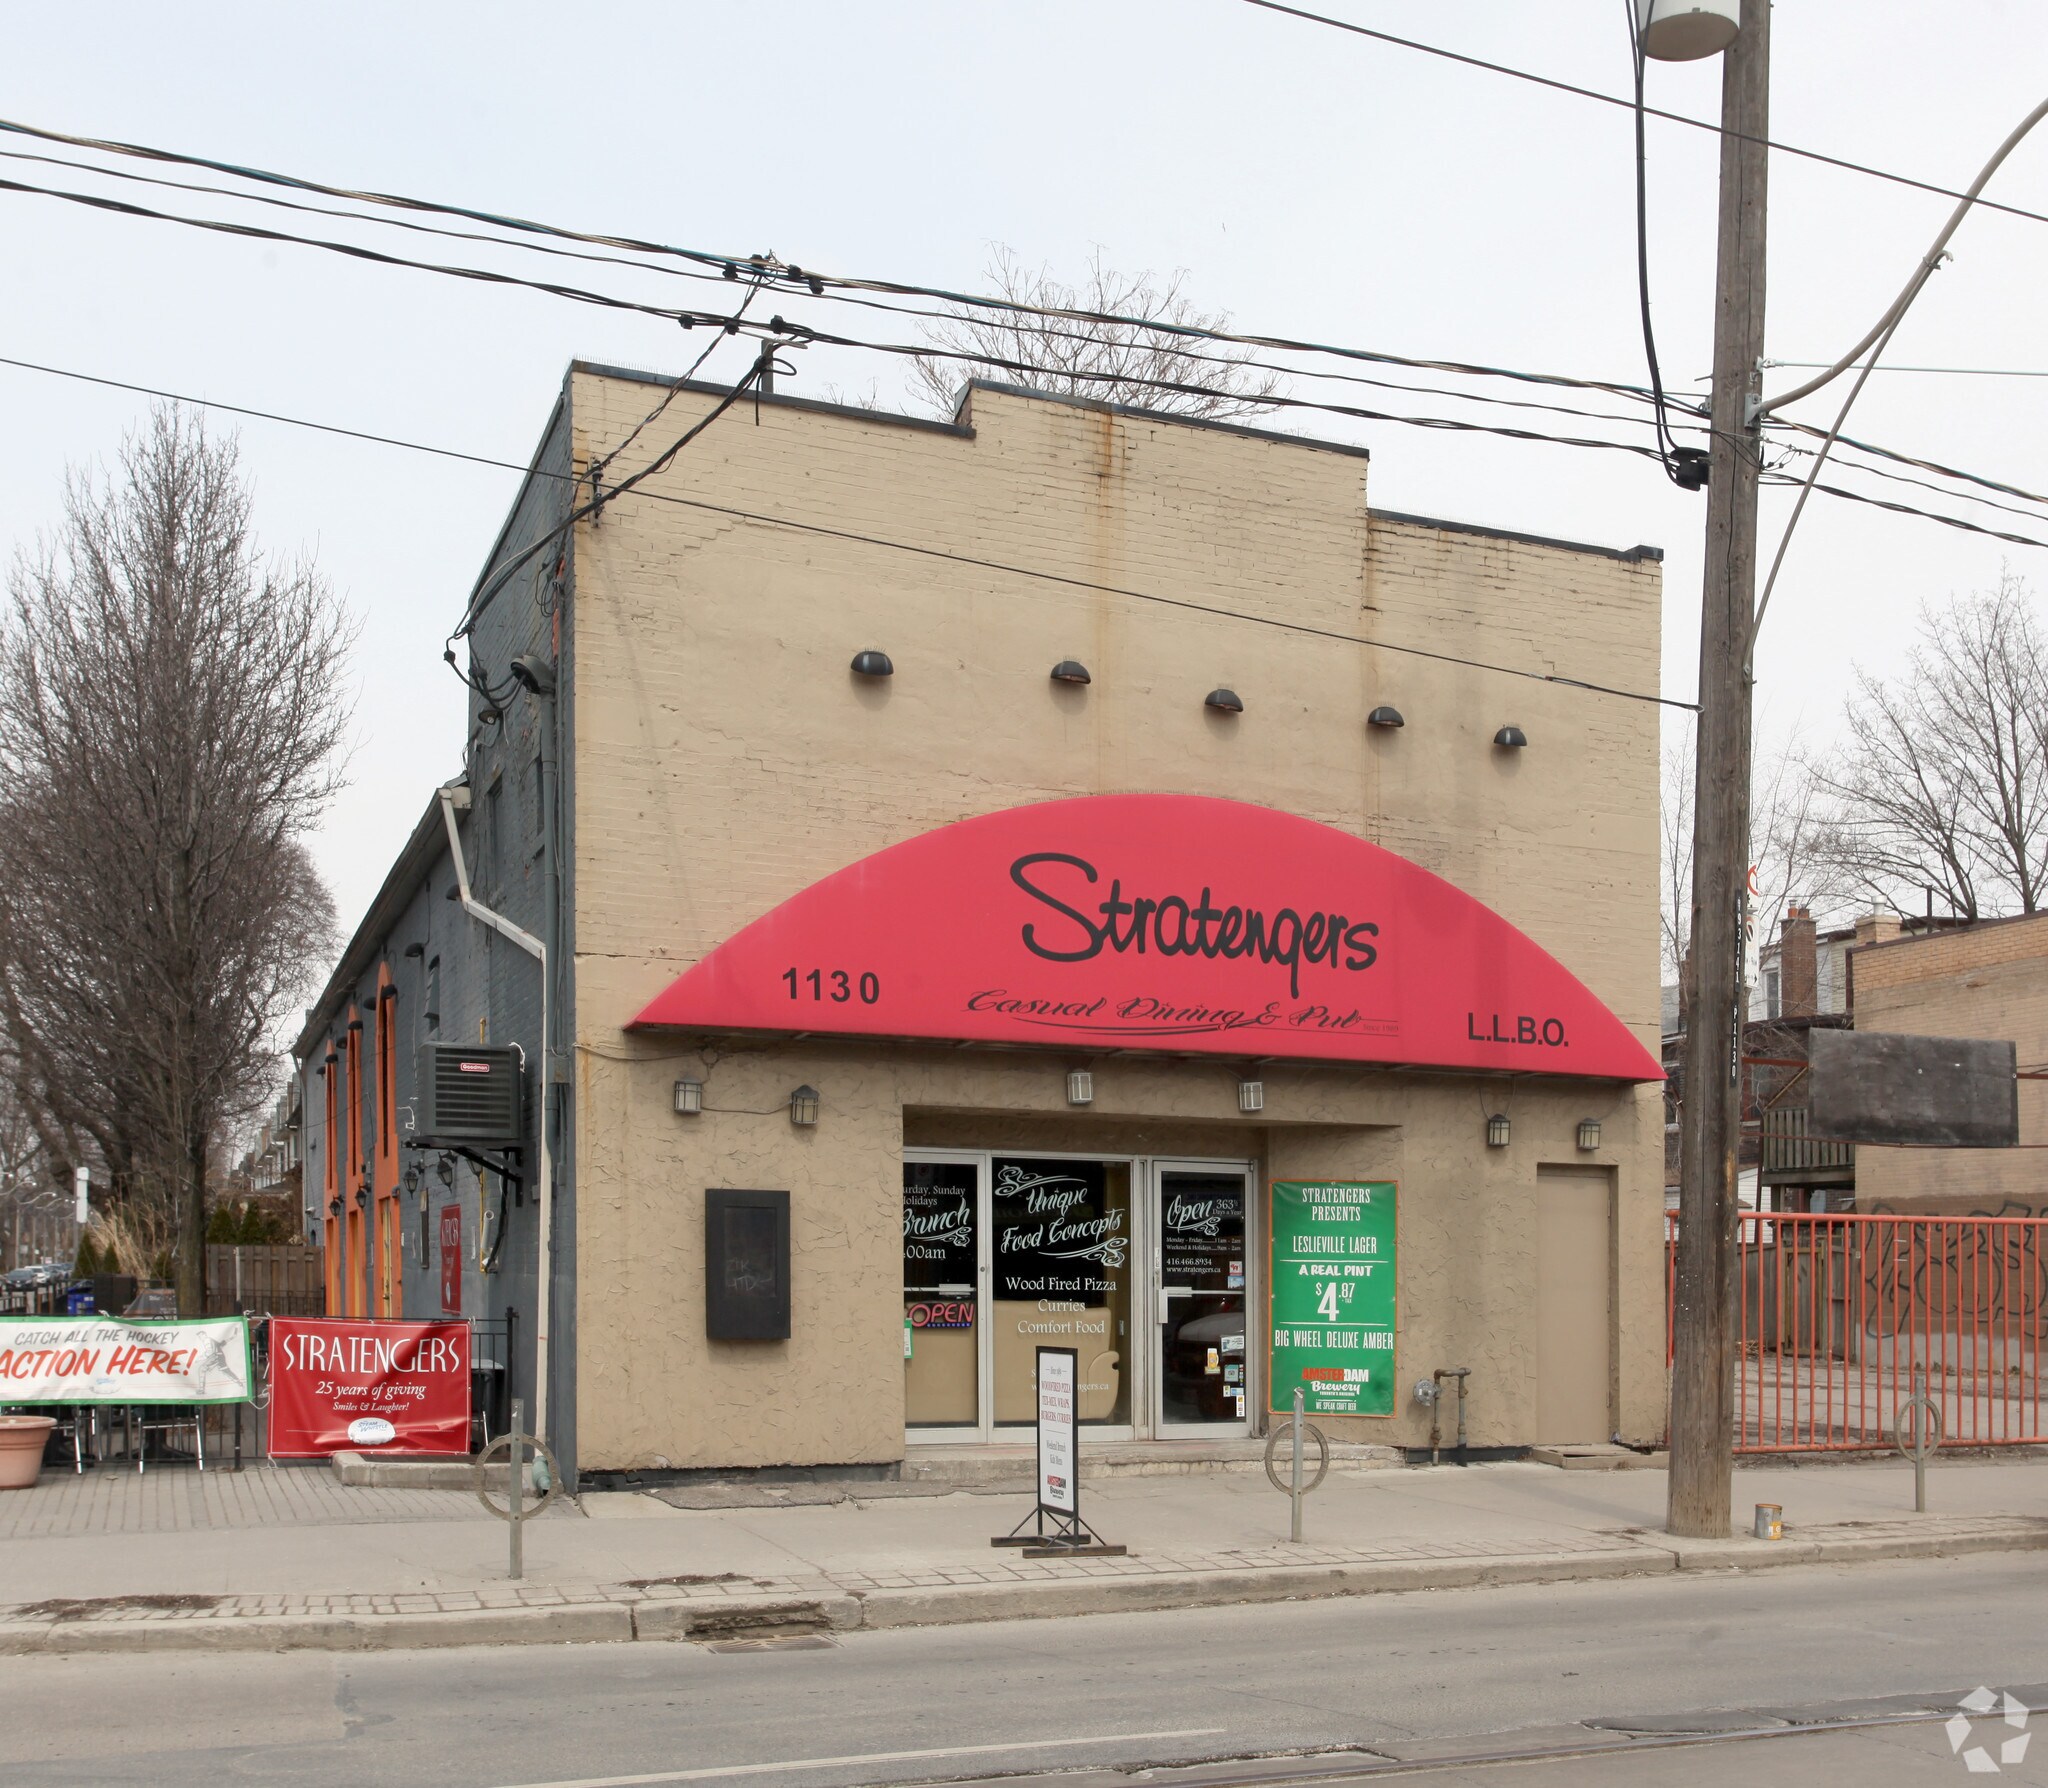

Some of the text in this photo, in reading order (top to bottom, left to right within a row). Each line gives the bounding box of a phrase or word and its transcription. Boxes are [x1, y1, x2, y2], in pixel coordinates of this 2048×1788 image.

[1010, 852, 1379, 999] Stratengers
[782, 967, 880, 1005] 1130
[961, 989, 1362, 1031] Casual Dining & Pub
[1467, 1012, 1569, 1047] L.L.B.O.
[903, 1184, 966, 1198] urday, Sunday
[1302, 1188, 1371, 1204] STRATENGERS
[1026, 1186, 1088, 1216] Unique
[903, 1197, 970, 1236] Brunch
[1166, 1194, 1213, 1234] Open
[1212, 1208, 1225, 1216] Days
[1312, 1206, 1361, 1222] PRESENTS
[1000, 1208, 1126, 1253] Food Concepts
[1293, 1235, 1377, 1254] LESLIEVILLE LAGER
[1298, 1264, 1373, 1277] A REAL PINT
[1005, 1276, 1117, 1291] Wood Fired Pizza
[908, 1302, 975, 1327] OPEN
[1037, 1298, 1086, 1312] Curries
[1017, 1320, 1071, 1334] Comfort
[1075, 1320, 1105, 1334] Food
[14, 1328, 180, 1346] CATCH ALL THE HOCKEY
[1275, 1330, 1394, 1350] BIG WHEEL DELUXE AMBER
[0, 1344, 198, 1379] ACTION HERE!
[283, 1333, 460, 1374] STRATENGERS
[315, 1381, 427, 1400] 25 years of giving
[1310, 1380, 1361, 1395] Brewery
[332, 1402, 410, 1414] Smiles & Laughter!
[1316, 1401, 1322, 1410] WE
[1323, 1401, 1335, 1410] SPEAK
